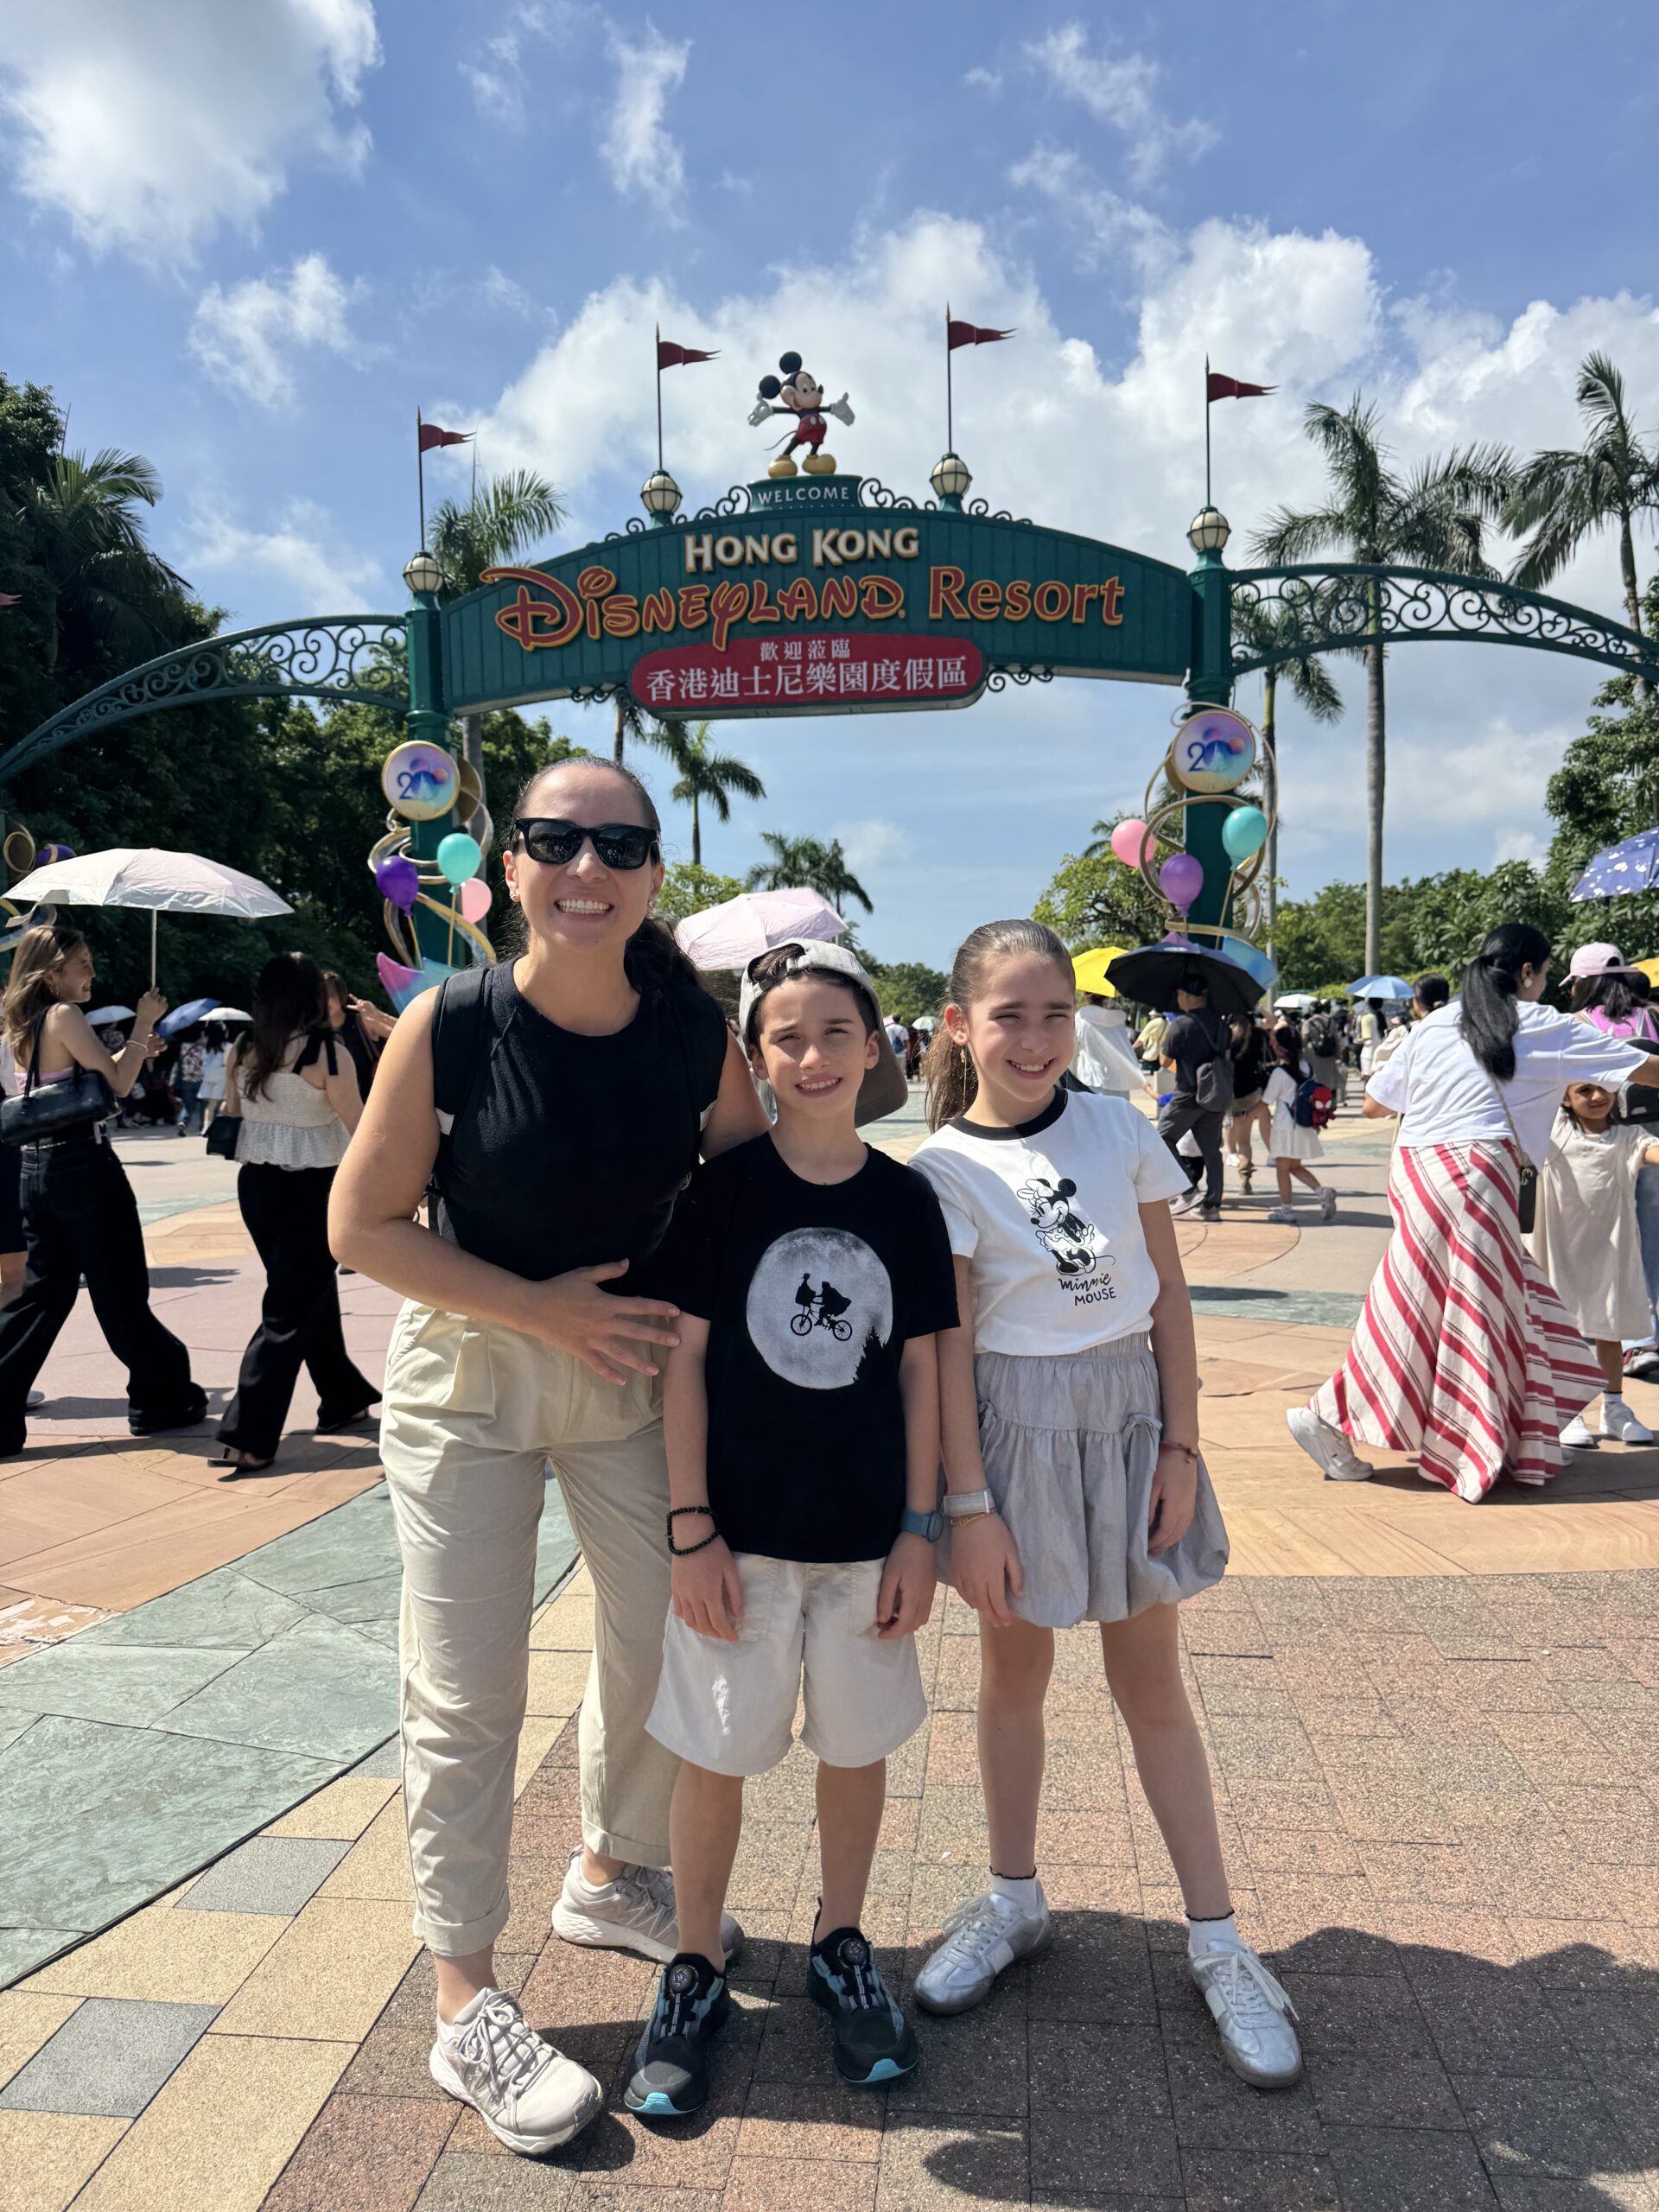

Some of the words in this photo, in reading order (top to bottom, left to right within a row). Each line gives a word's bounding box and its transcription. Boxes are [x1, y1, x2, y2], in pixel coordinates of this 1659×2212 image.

[758, 486, 849, 505] WELCOME
[684, 533, 798, 573] HONG
[812, 528, 919, 567] KONG
[929, 566, 1124, 626] Resort
[646, 655, 968, 702] 香港迪士尼樂園度假區
[1074, 1287, 1116, 1306] MOUSE
